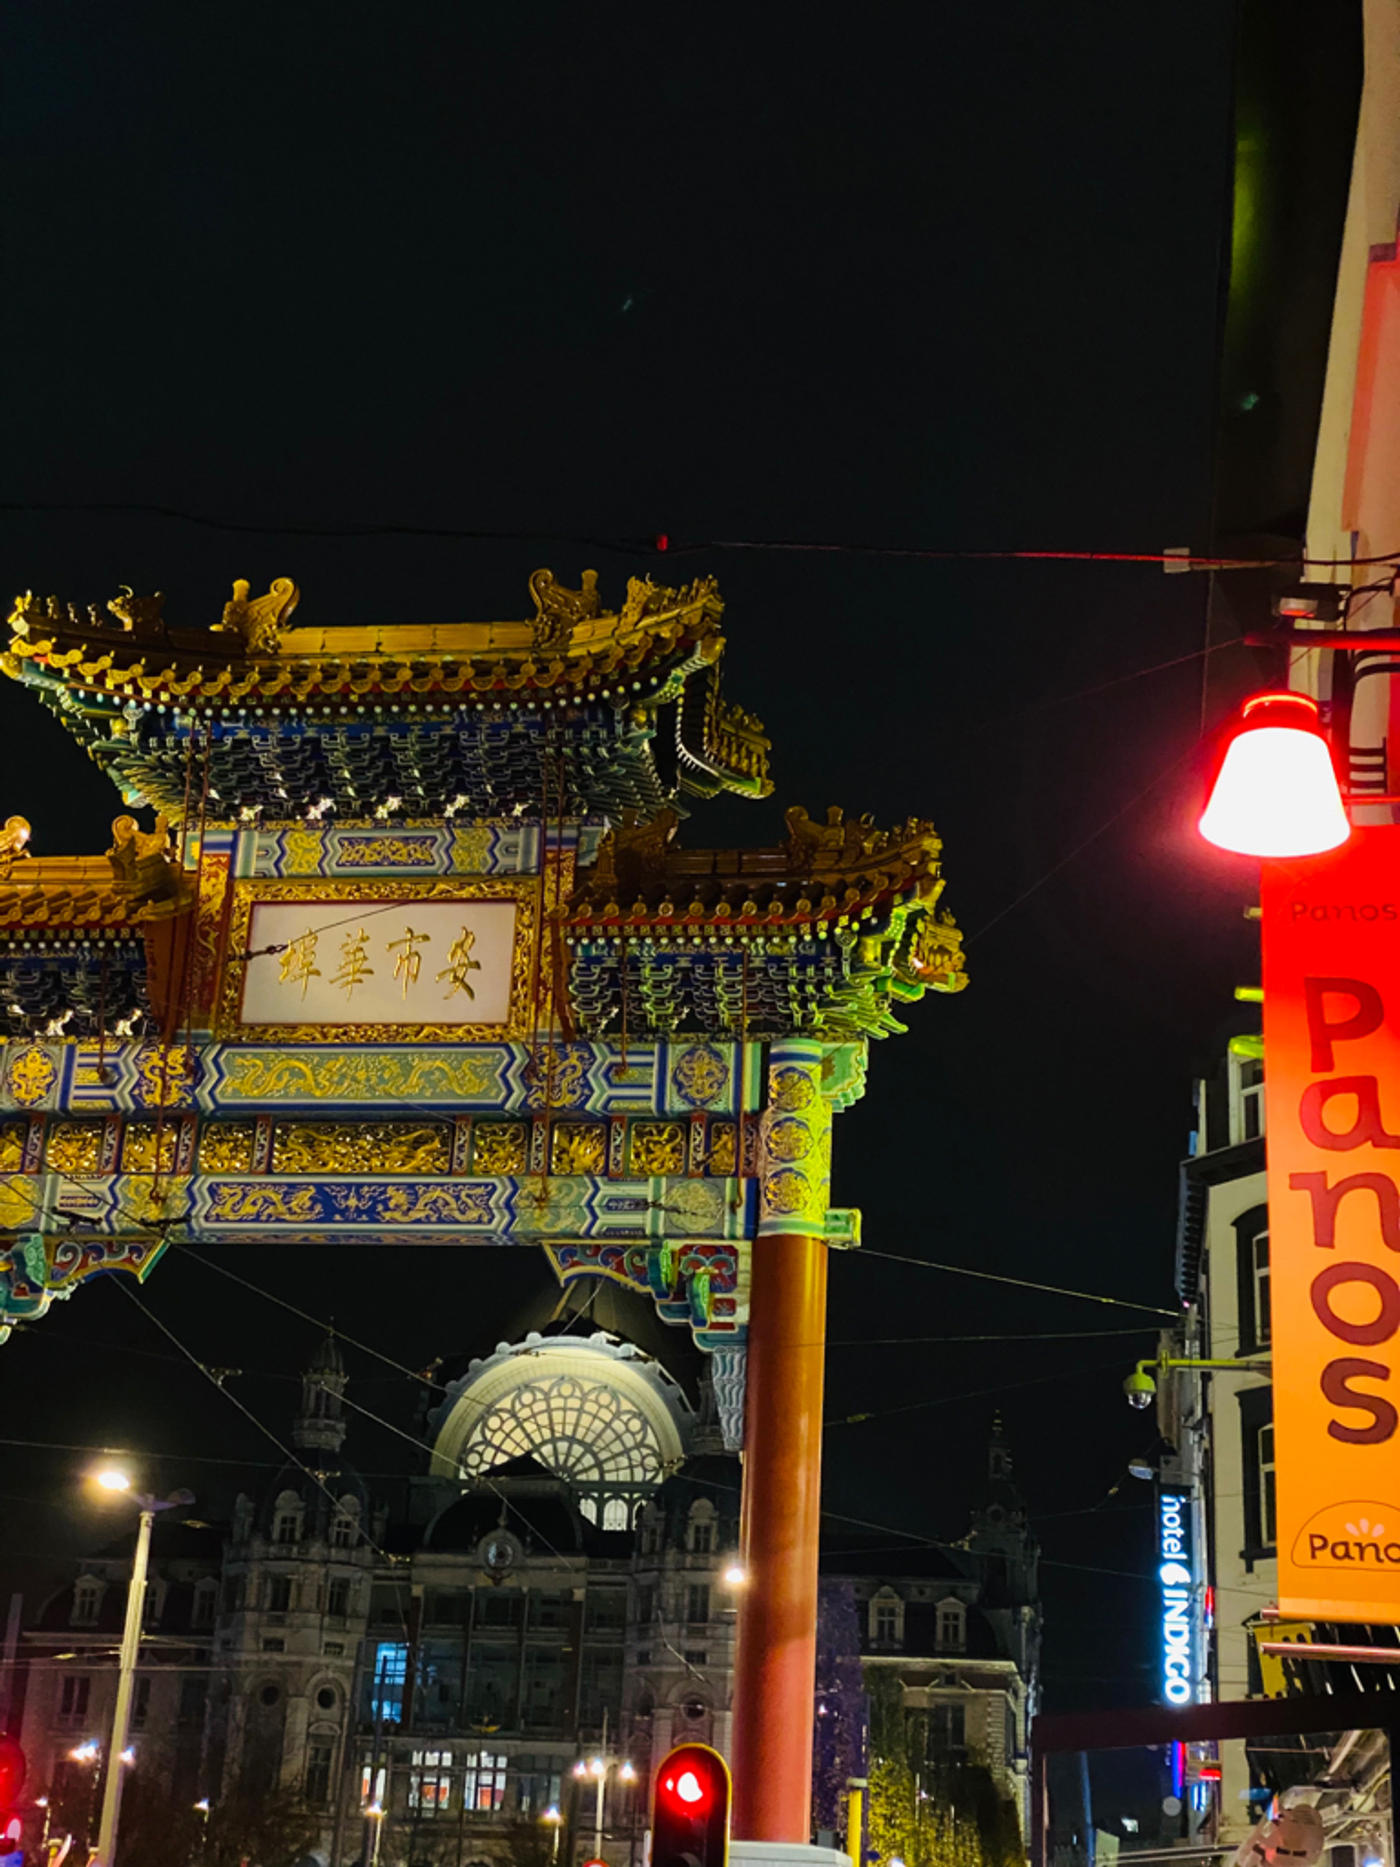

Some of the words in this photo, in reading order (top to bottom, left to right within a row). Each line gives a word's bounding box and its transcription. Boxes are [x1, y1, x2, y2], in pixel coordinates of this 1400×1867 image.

[1291, 902, 1398, 922] Panos
[1290, 976, 1400, 1445] Panos
[1161, 1495, 1188, 1560] hotel
[1163, 1588, 1191, 1704] INDIGO
